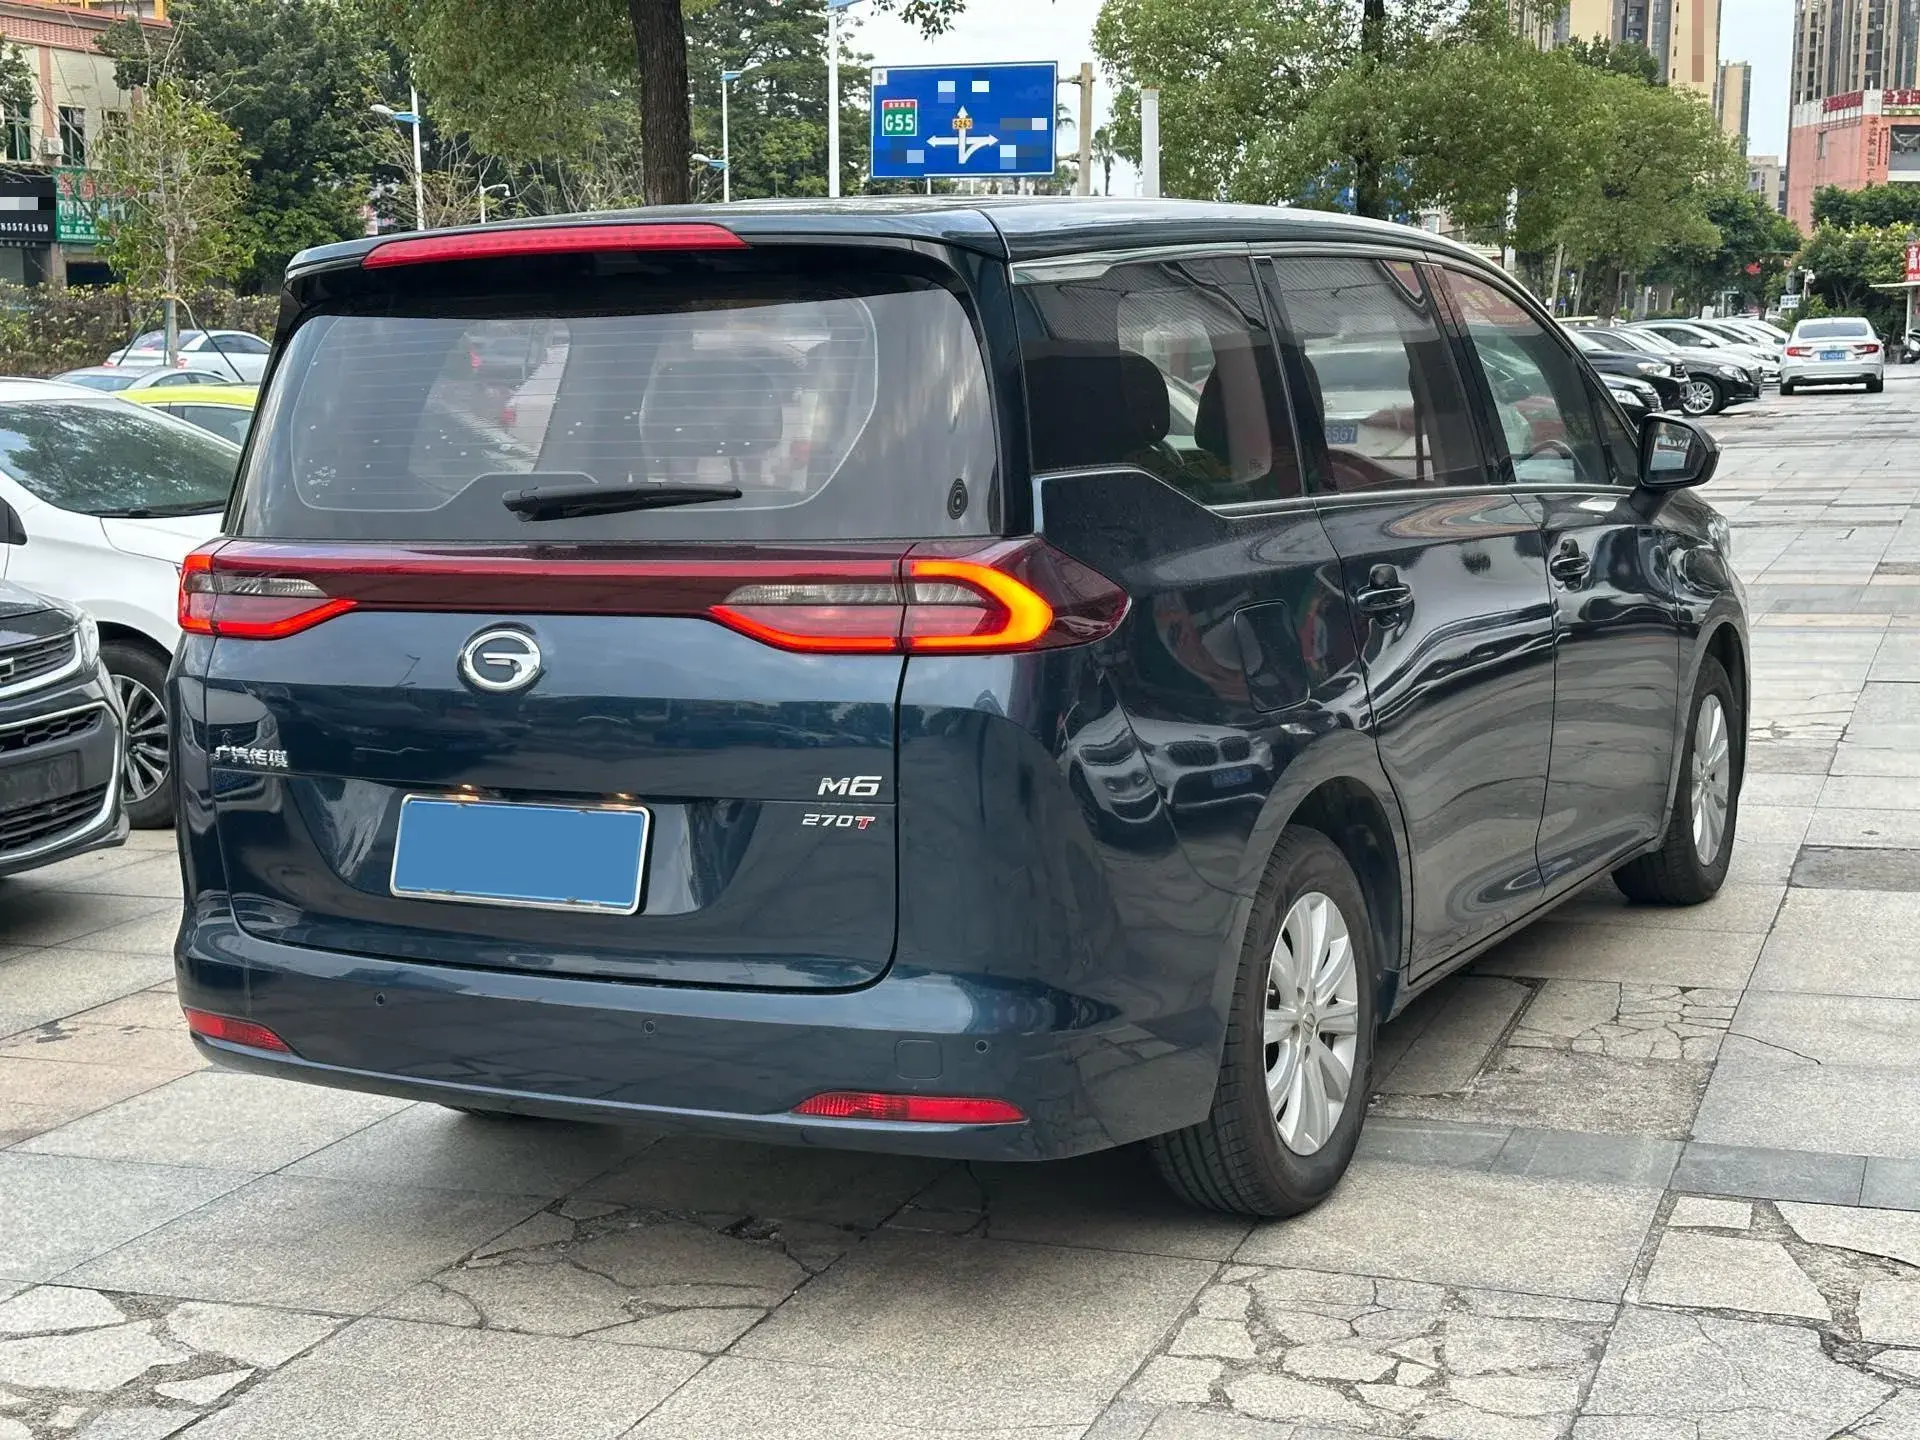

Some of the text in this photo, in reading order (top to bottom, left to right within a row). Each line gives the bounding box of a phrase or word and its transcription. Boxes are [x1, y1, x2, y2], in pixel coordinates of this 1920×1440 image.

[885, 114, 914, 131] G55
[817, 775, 883, 796] M6
[802, 813, 876, 830] 270T
